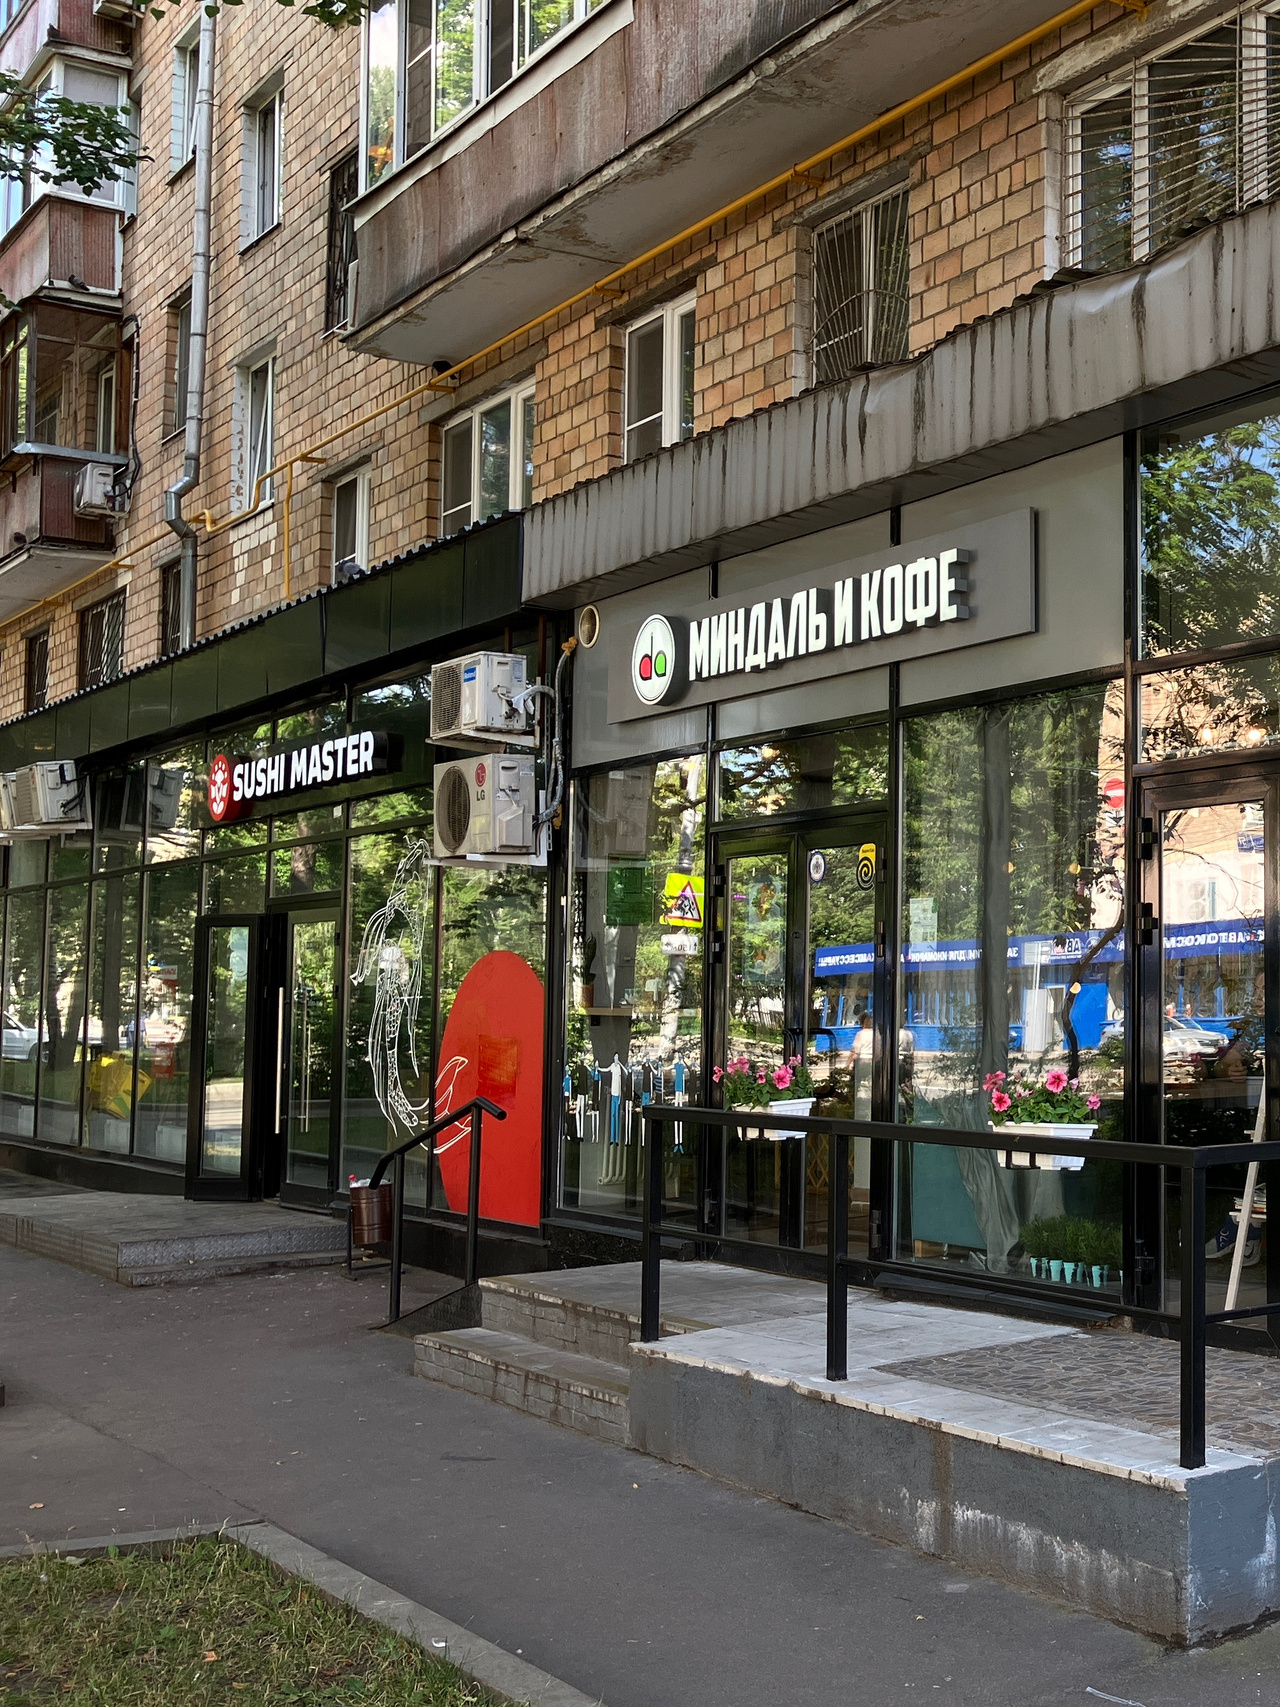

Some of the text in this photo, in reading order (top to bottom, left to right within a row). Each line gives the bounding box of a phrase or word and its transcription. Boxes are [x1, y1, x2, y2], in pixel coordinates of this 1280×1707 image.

[689, 547, 958, 681] МИНДАЛЬ И КОФЕ
[232, 730, 375, 802] SUSHI MASTER
[476, 789, 486, 802] LG
